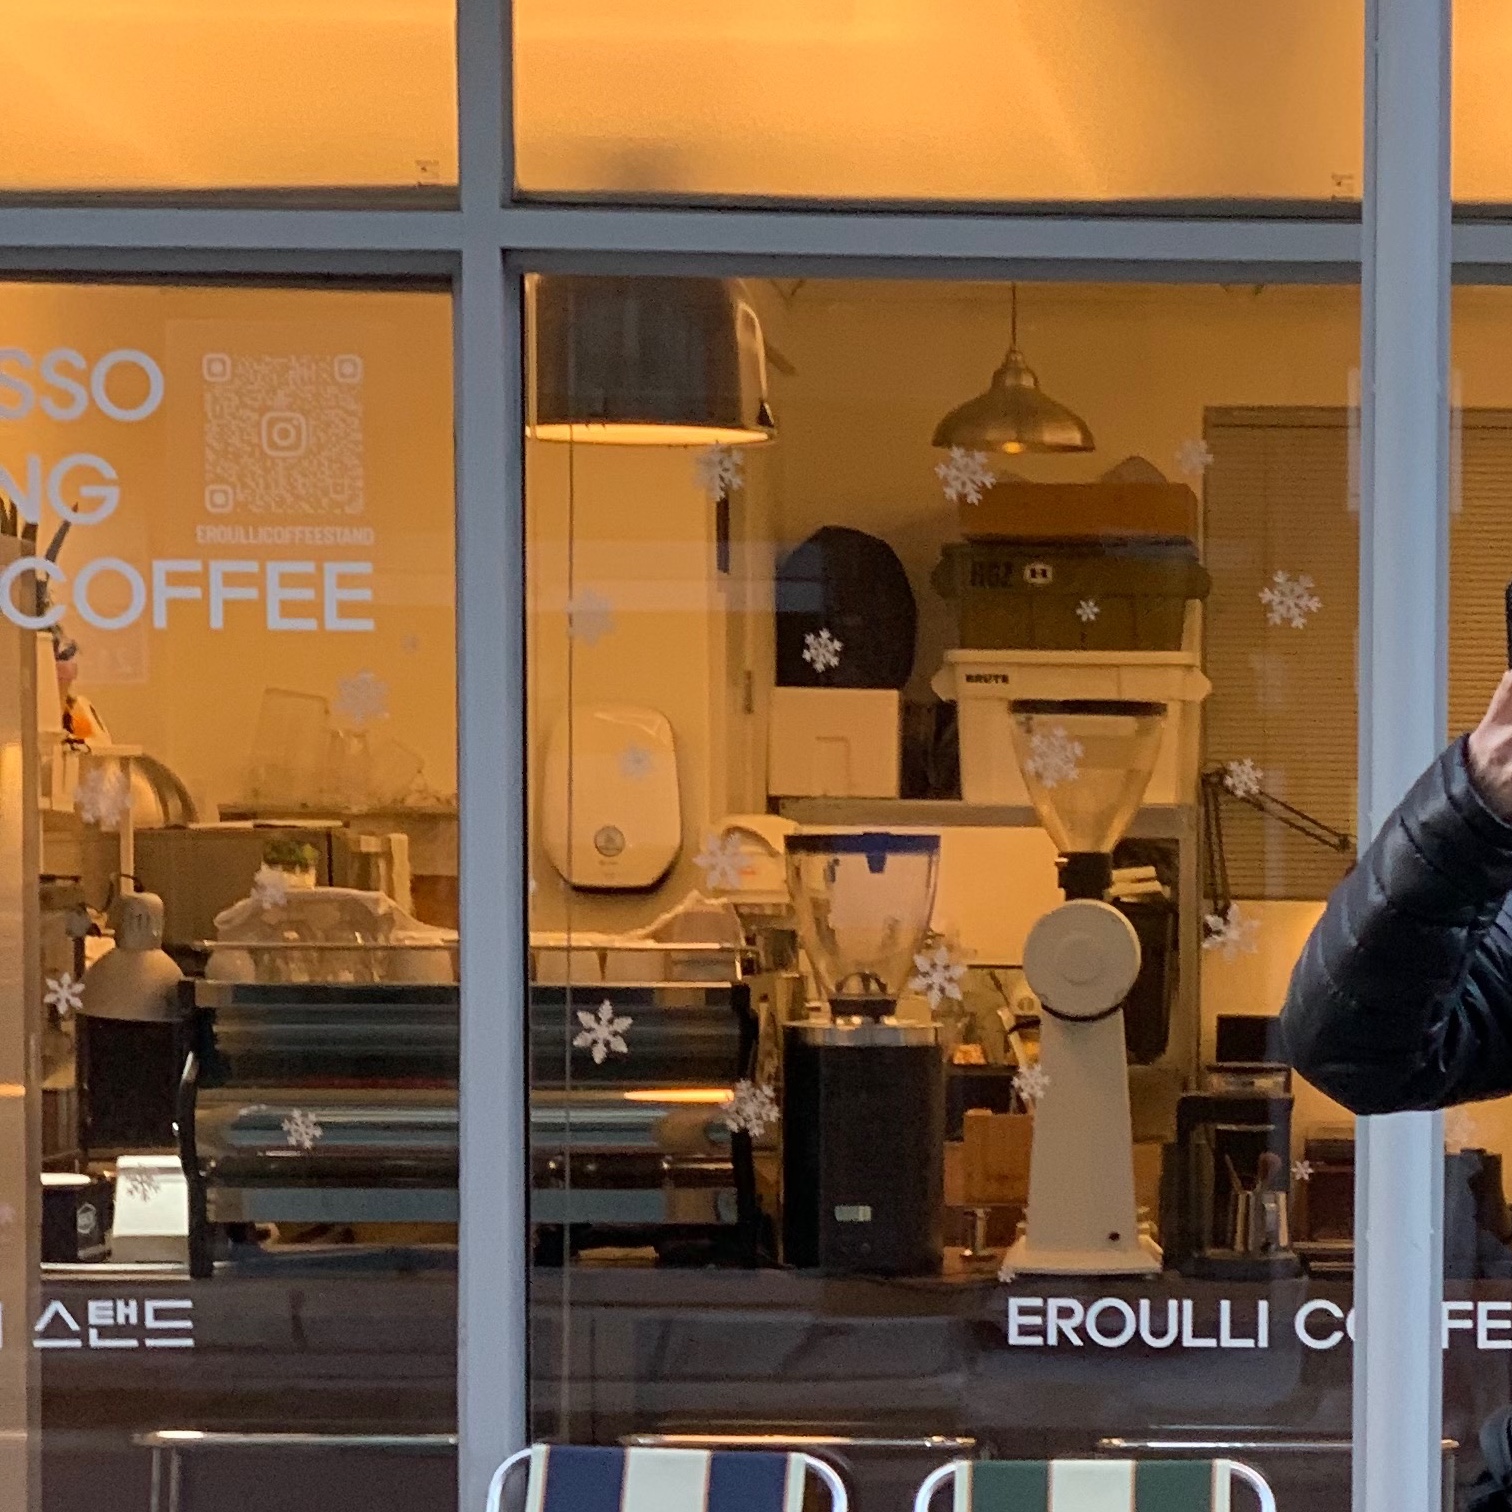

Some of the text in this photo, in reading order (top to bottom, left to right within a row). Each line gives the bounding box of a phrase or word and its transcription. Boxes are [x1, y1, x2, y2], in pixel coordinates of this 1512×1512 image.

[0, 557, 374, 630] COFFEE
[33, 1299, 195, 1348] 스탠드
[1008, 1297, 1269, 1348] EROULLI
